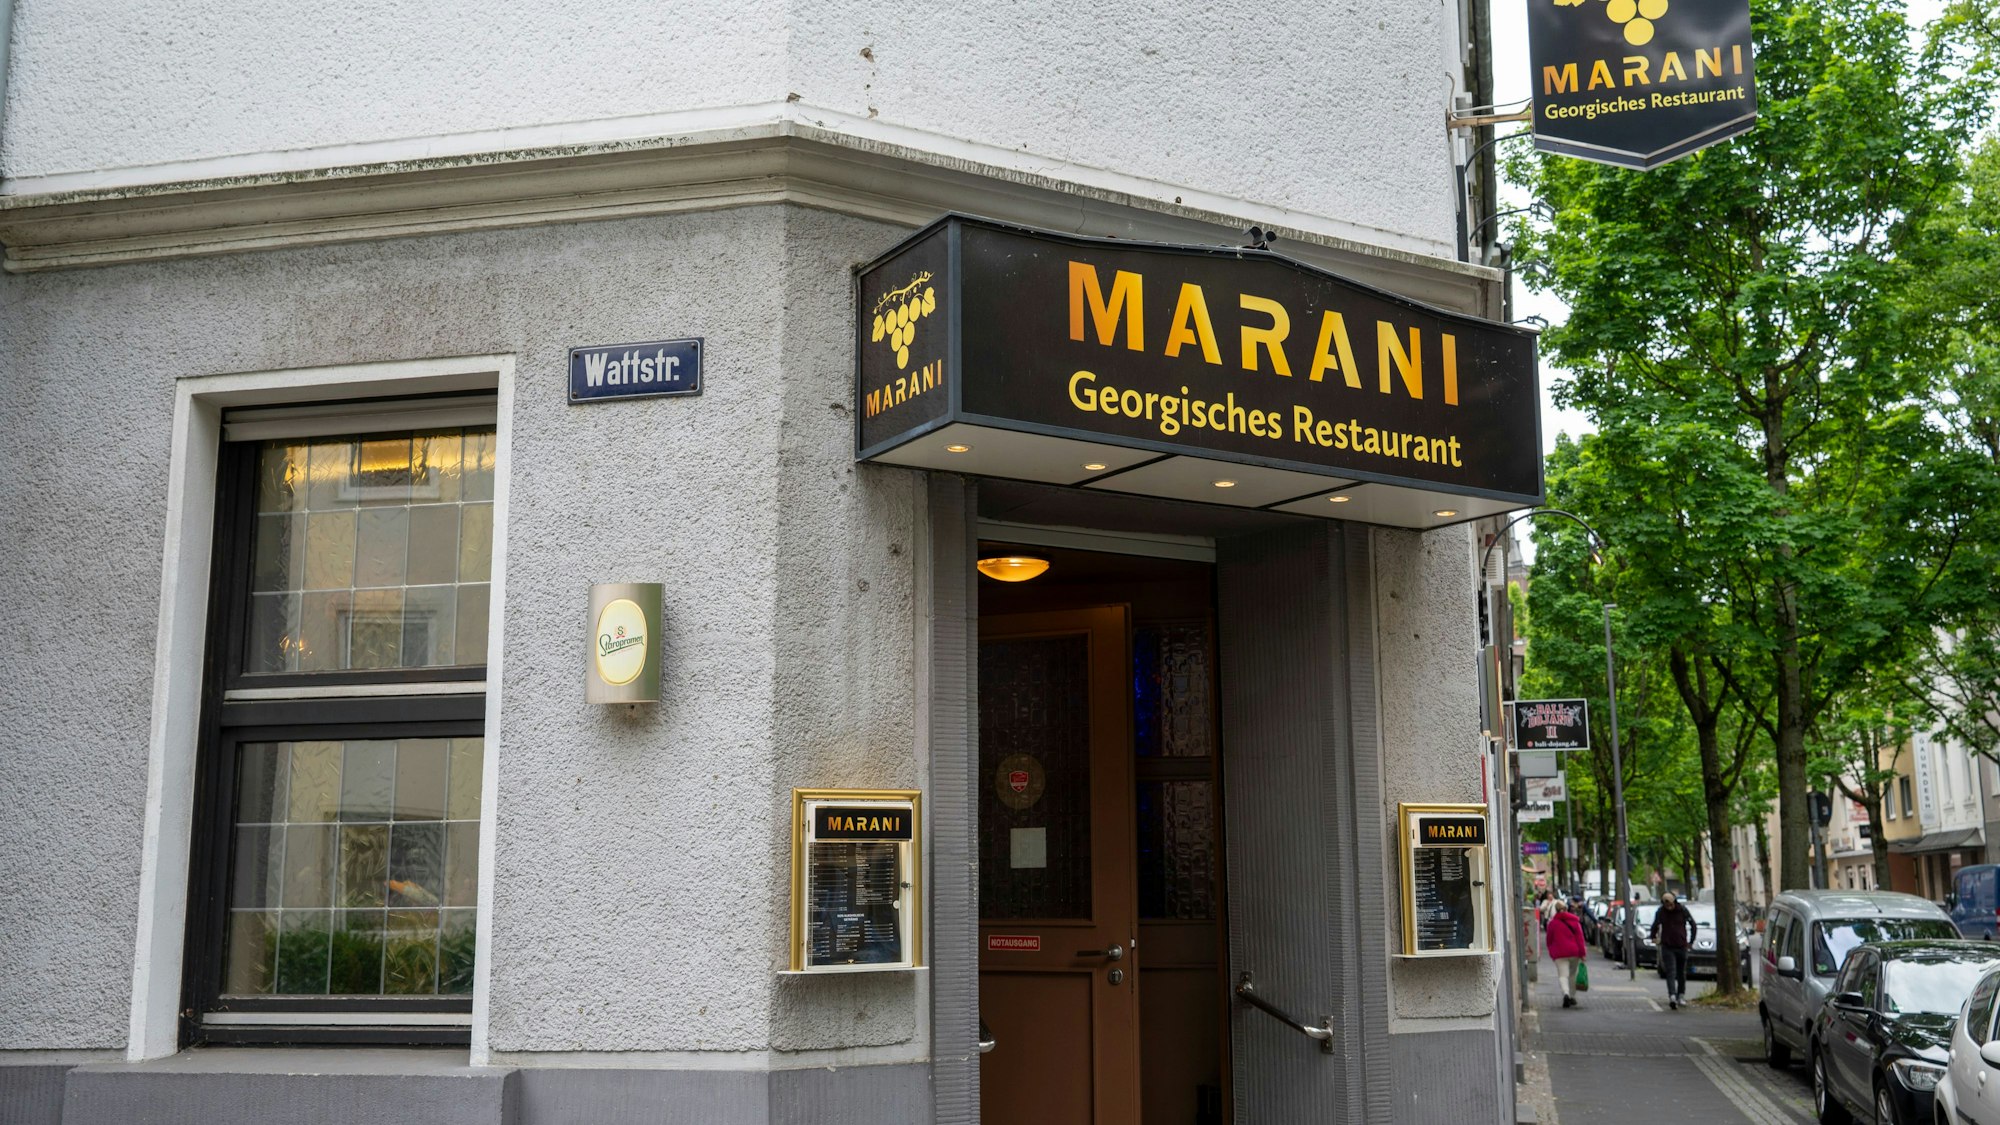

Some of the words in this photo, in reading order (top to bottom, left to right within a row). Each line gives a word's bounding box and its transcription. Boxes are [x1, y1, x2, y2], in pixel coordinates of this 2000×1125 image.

[1543, 45, 1743, 96] MARANI
[1544, 96, 1646, 120] Georgisches
[1651, 86, 1745, 109] Restaurant
[1068, 260, 1459, 406] MARANI
[584, 348, 680, 388] Wattstr.
[866, 359, 942, 418] MARANI
[1068, 370, 1282, 436] Georgisches
[1294, 405, 1462, 468] Restaurant
[599, 634, 644, 657] Staropramen
[1536, 703, 1563, 715] BALI
[1528, 714, 1574, 728] DOJANG
[1534, 740, 1579, 749] bali-dojang.de
[828, 816, 901, 832] MARANI
[1428, 825, 1478, 838] MARANI
[990, 938, 1038, 948] NOTAUSGANG
